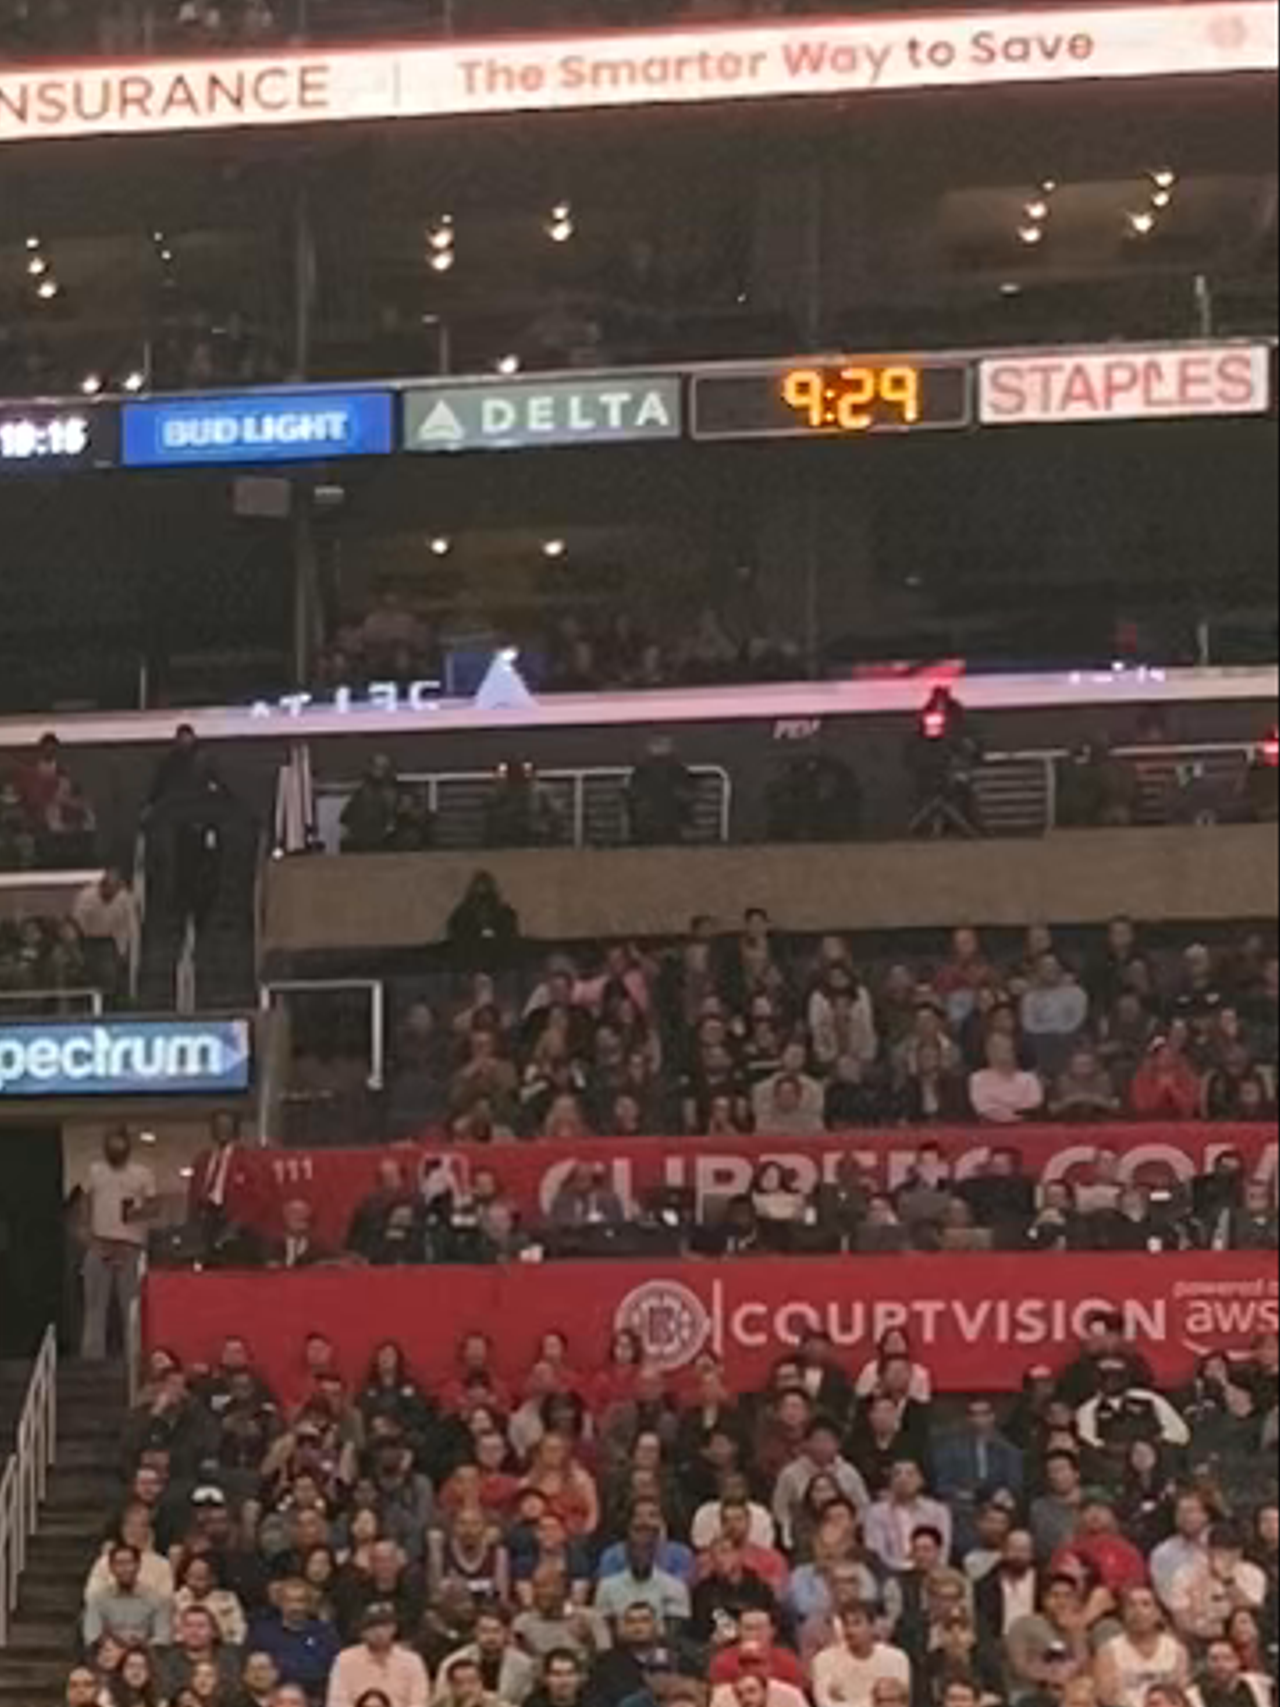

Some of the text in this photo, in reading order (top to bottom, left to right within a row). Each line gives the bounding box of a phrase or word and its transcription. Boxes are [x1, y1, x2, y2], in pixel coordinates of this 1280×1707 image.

[457, 28, 1096, 95] The Smarter Way to Save
[782, 365, 919, 430] 9:29
[986, 355, 1254, 416] STAPLES
[161, 410, 349, 448] BUD LIGHT
[481, 391, 672, 435] DELTA
[1186, 1298, 1279, 1334] aws
